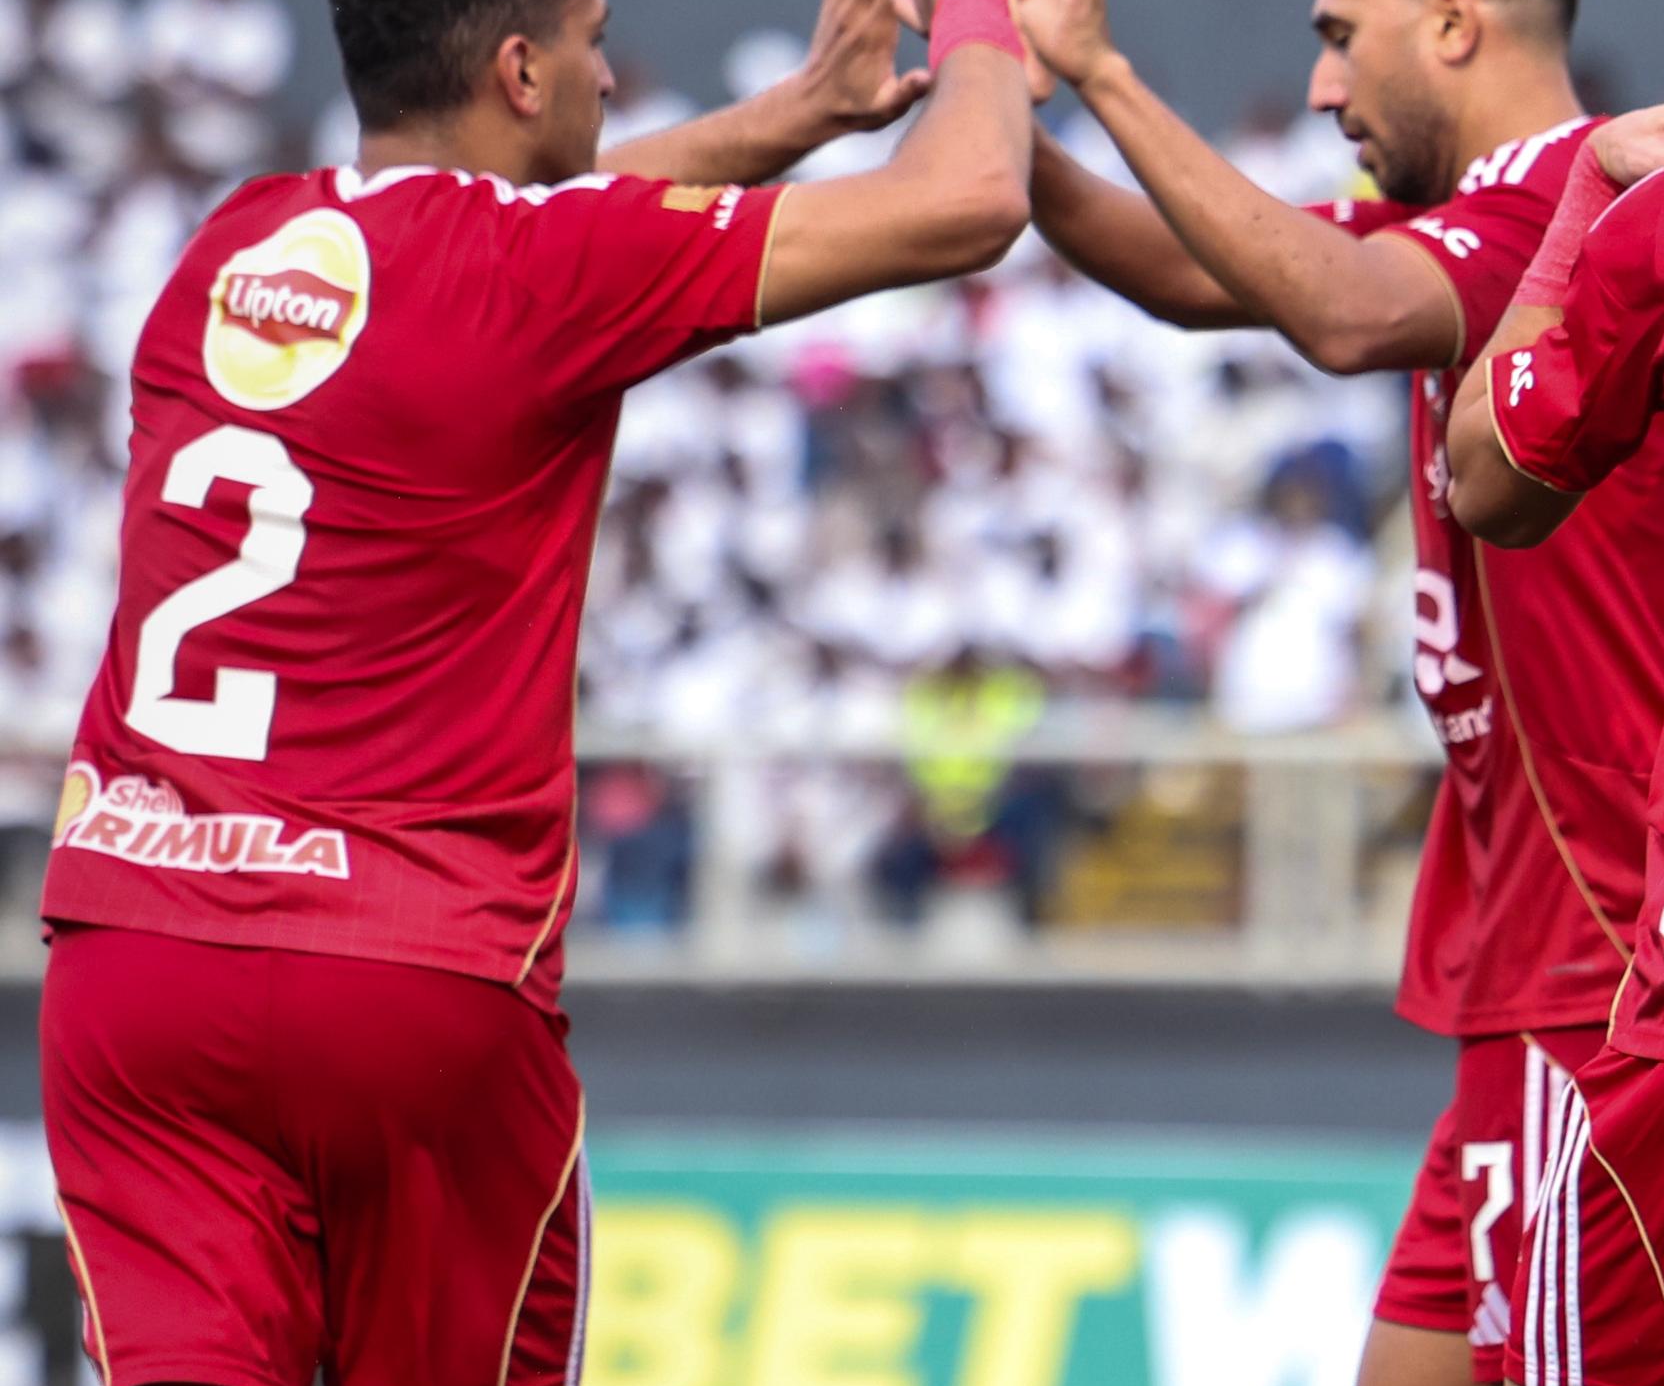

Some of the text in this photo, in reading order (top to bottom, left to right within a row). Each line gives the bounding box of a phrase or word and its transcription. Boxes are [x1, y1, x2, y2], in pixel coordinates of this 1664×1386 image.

[228, 276, 341, 331] Lipton
[125, 424, 313, 761] 2
[78, 811, 344, 873] RIMULA
[1461, 1140, 1513, 1282] 7
